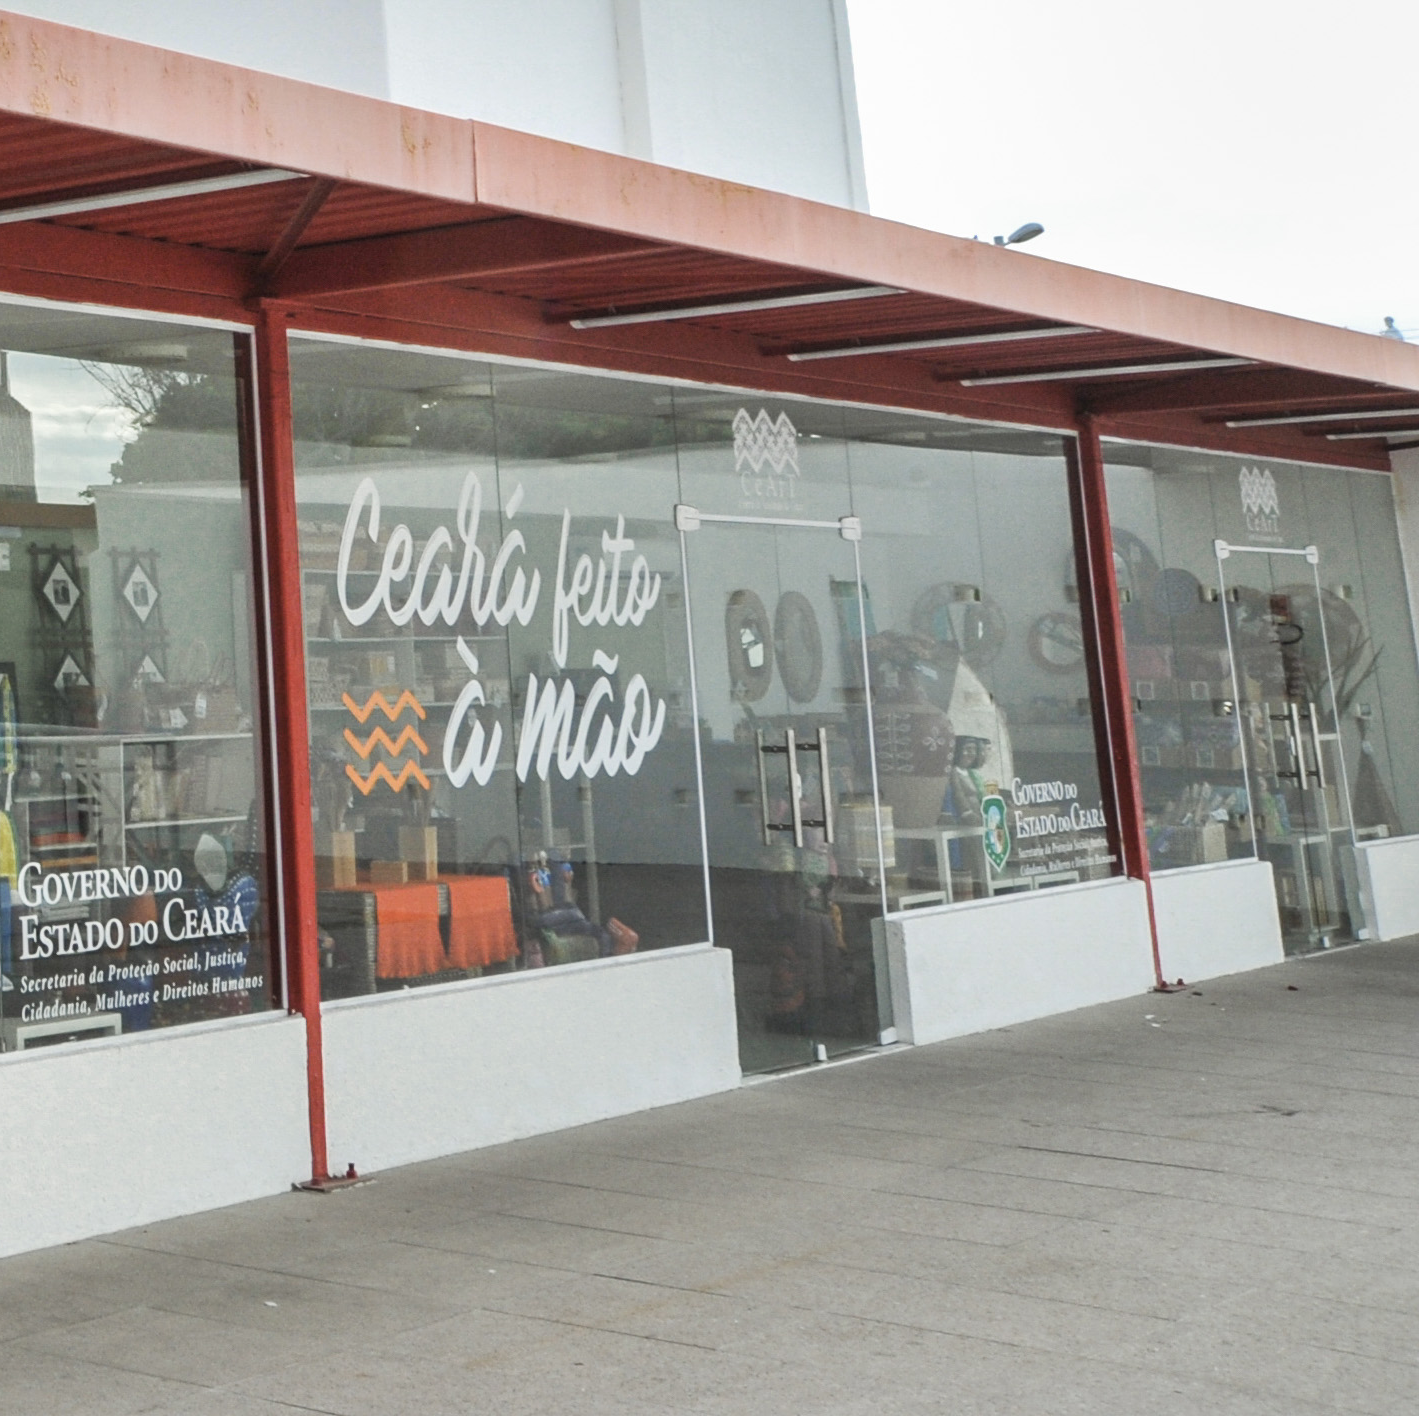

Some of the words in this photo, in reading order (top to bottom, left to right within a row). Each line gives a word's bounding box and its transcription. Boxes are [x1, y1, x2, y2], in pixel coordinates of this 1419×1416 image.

[337, 471, 540, 626] Ceará
[553, 508, 661, 669] feito
[443, 636, 502, 788] à
[516, 649, 665, 783] mão
[1012, 777, 1063, 806] GOVERNO
[1065, 783, 1077, 798] DO
[1014, 810, 1057, 838] ESTADO
[18, 861, 148, 907] GOVERNO
[153, 867, 182, 892] DO
[20, 914, 124, 960] ESTADO
[129, 920, 158, 946] DO
[163, 893, 246, 941] CEARÁ
[21, 969, 85, 994] Secretaria
[89, 967, 104, 983] da
[108, 960, 160, 984] Proteção
[163, 954, 201, 974] Social,
[203, 949, 246, 971] Justiça,
[21, 997, 91, 1022] Cidadania,
[95, 990, 150, 1012] Mulheres
[153, 991, 159, 1001] e
[163, 981, 209, 1001] Direitos
[212, 973, 264, 995] Humanos
